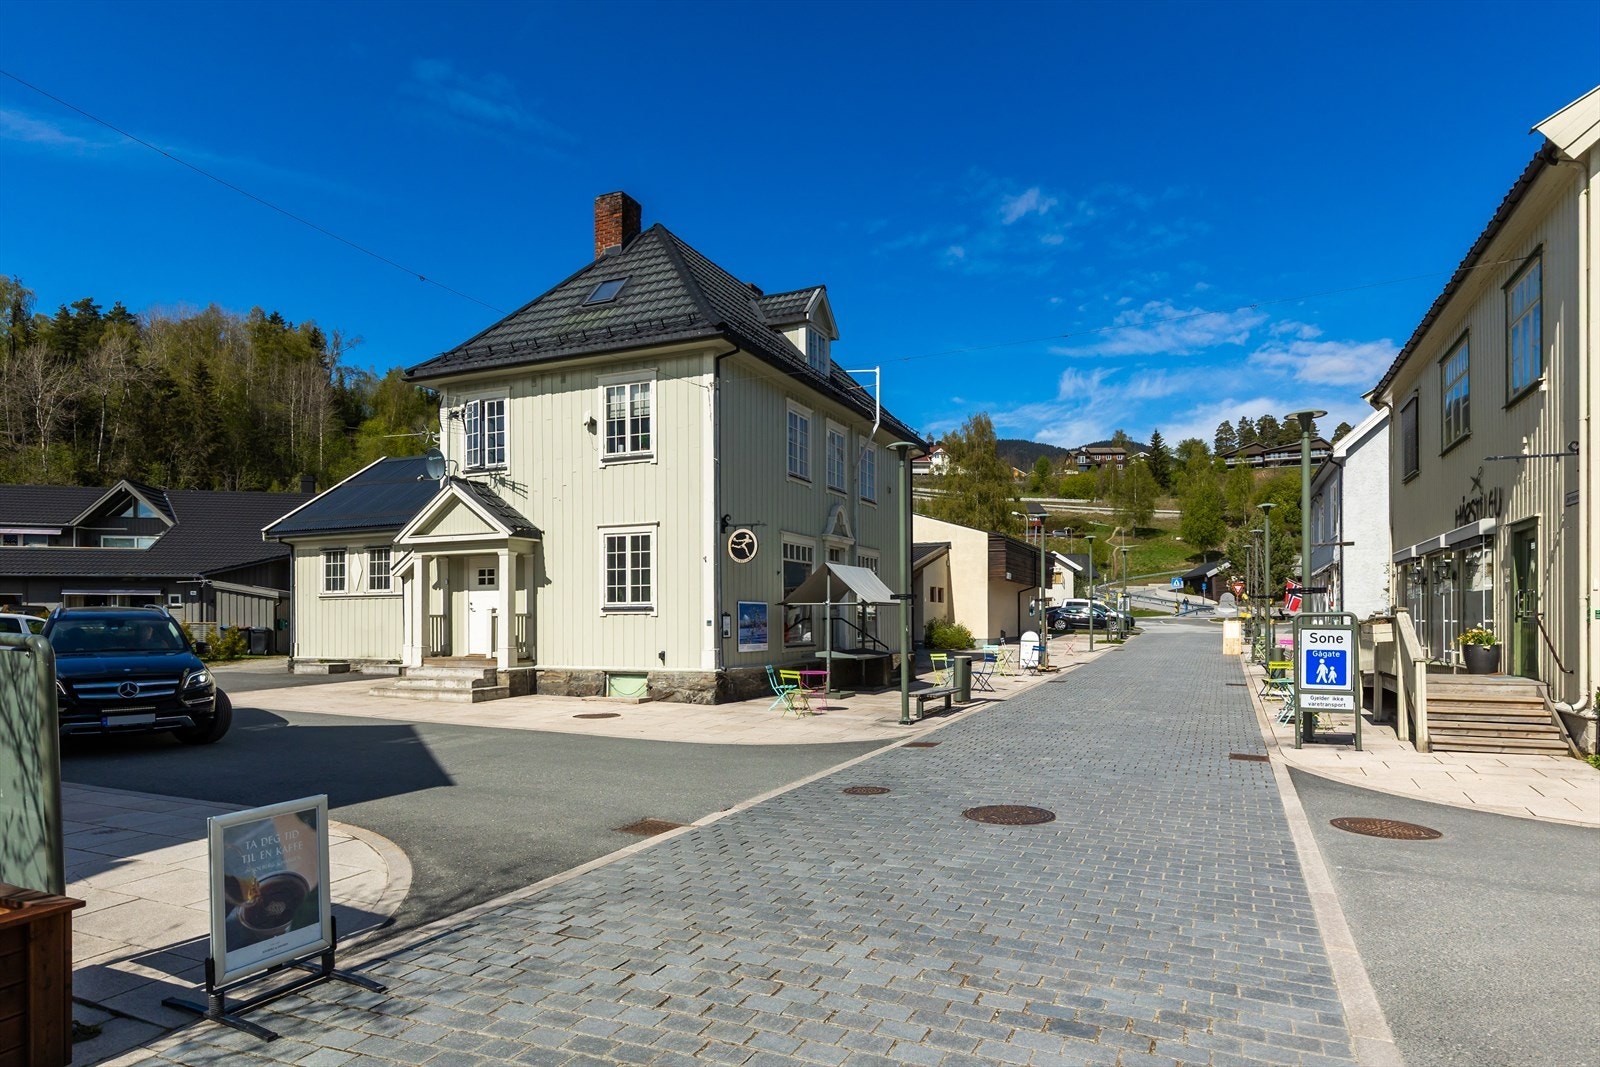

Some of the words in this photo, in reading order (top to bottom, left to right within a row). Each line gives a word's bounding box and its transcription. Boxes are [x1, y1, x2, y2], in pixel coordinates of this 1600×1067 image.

[1309, 632, 1344, 644] Sone
[1312, 650, 1340, 659] Gågate
[246, 840, 258, 850] TA
[261, 833, 281, 847] DEG
[284, 830, 300, 841] TID
[241, 853, 256, 864] TIL
[260, 849, 272, 860] EN
[275, 840, 304, 856] KAFFE
